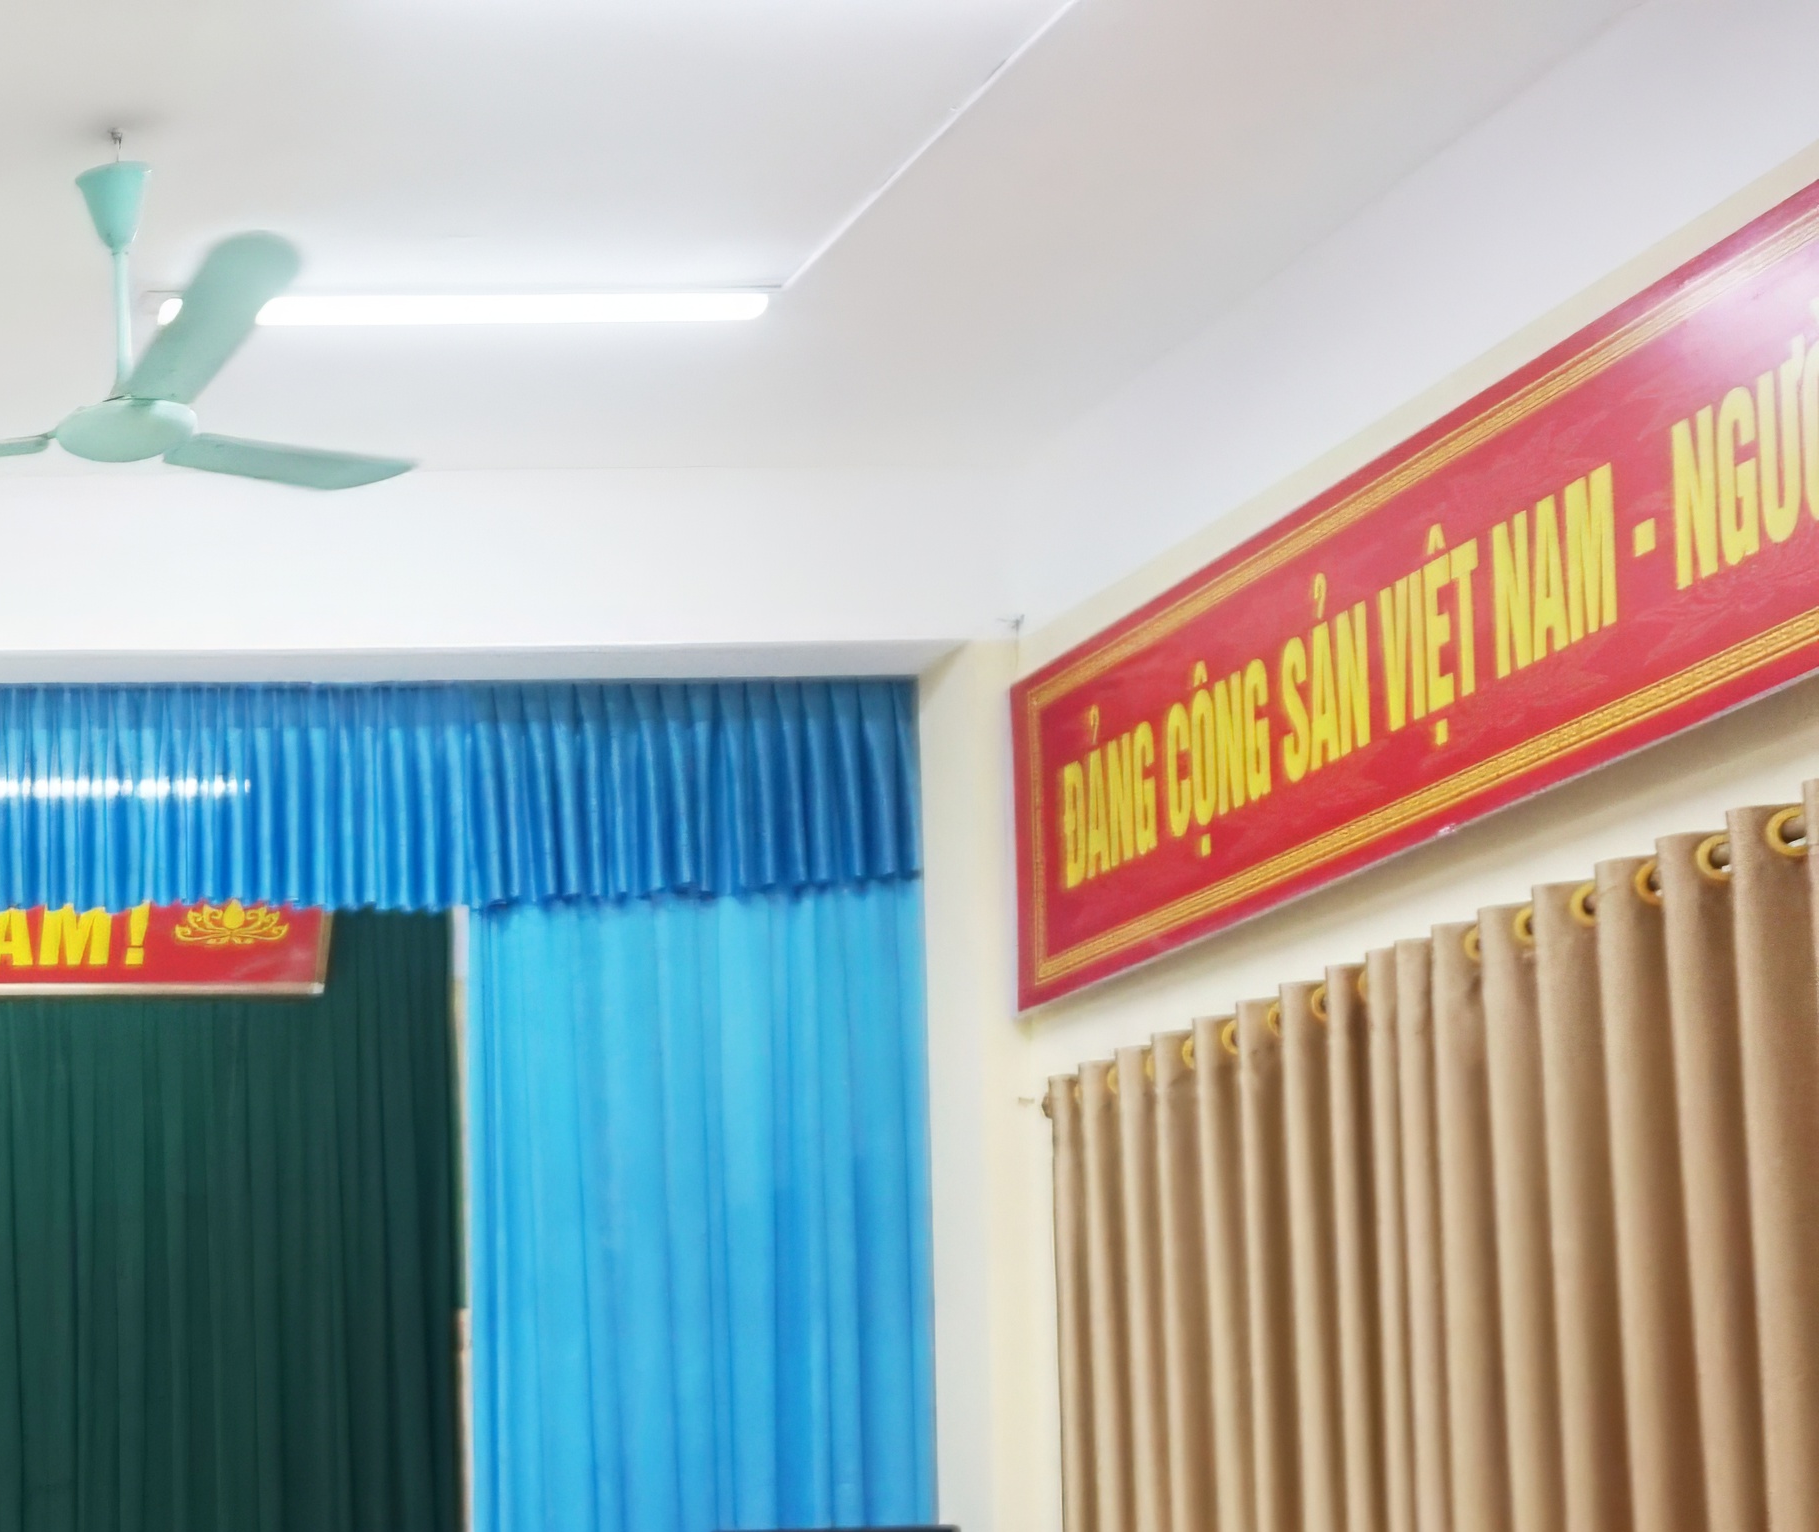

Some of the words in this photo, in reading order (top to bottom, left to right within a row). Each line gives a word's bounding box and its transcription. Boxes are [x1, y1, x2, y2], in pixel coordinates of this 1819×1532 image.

[1062, 704, 1157, 890] ĐẢNG
[1166, 660, 1272, 857] CỘNG
[1280, 572, 1371, 783] SẢN
[1378, 523, 1479, 746] VIỆT
[1491, 462, 1618, 679] NAM
